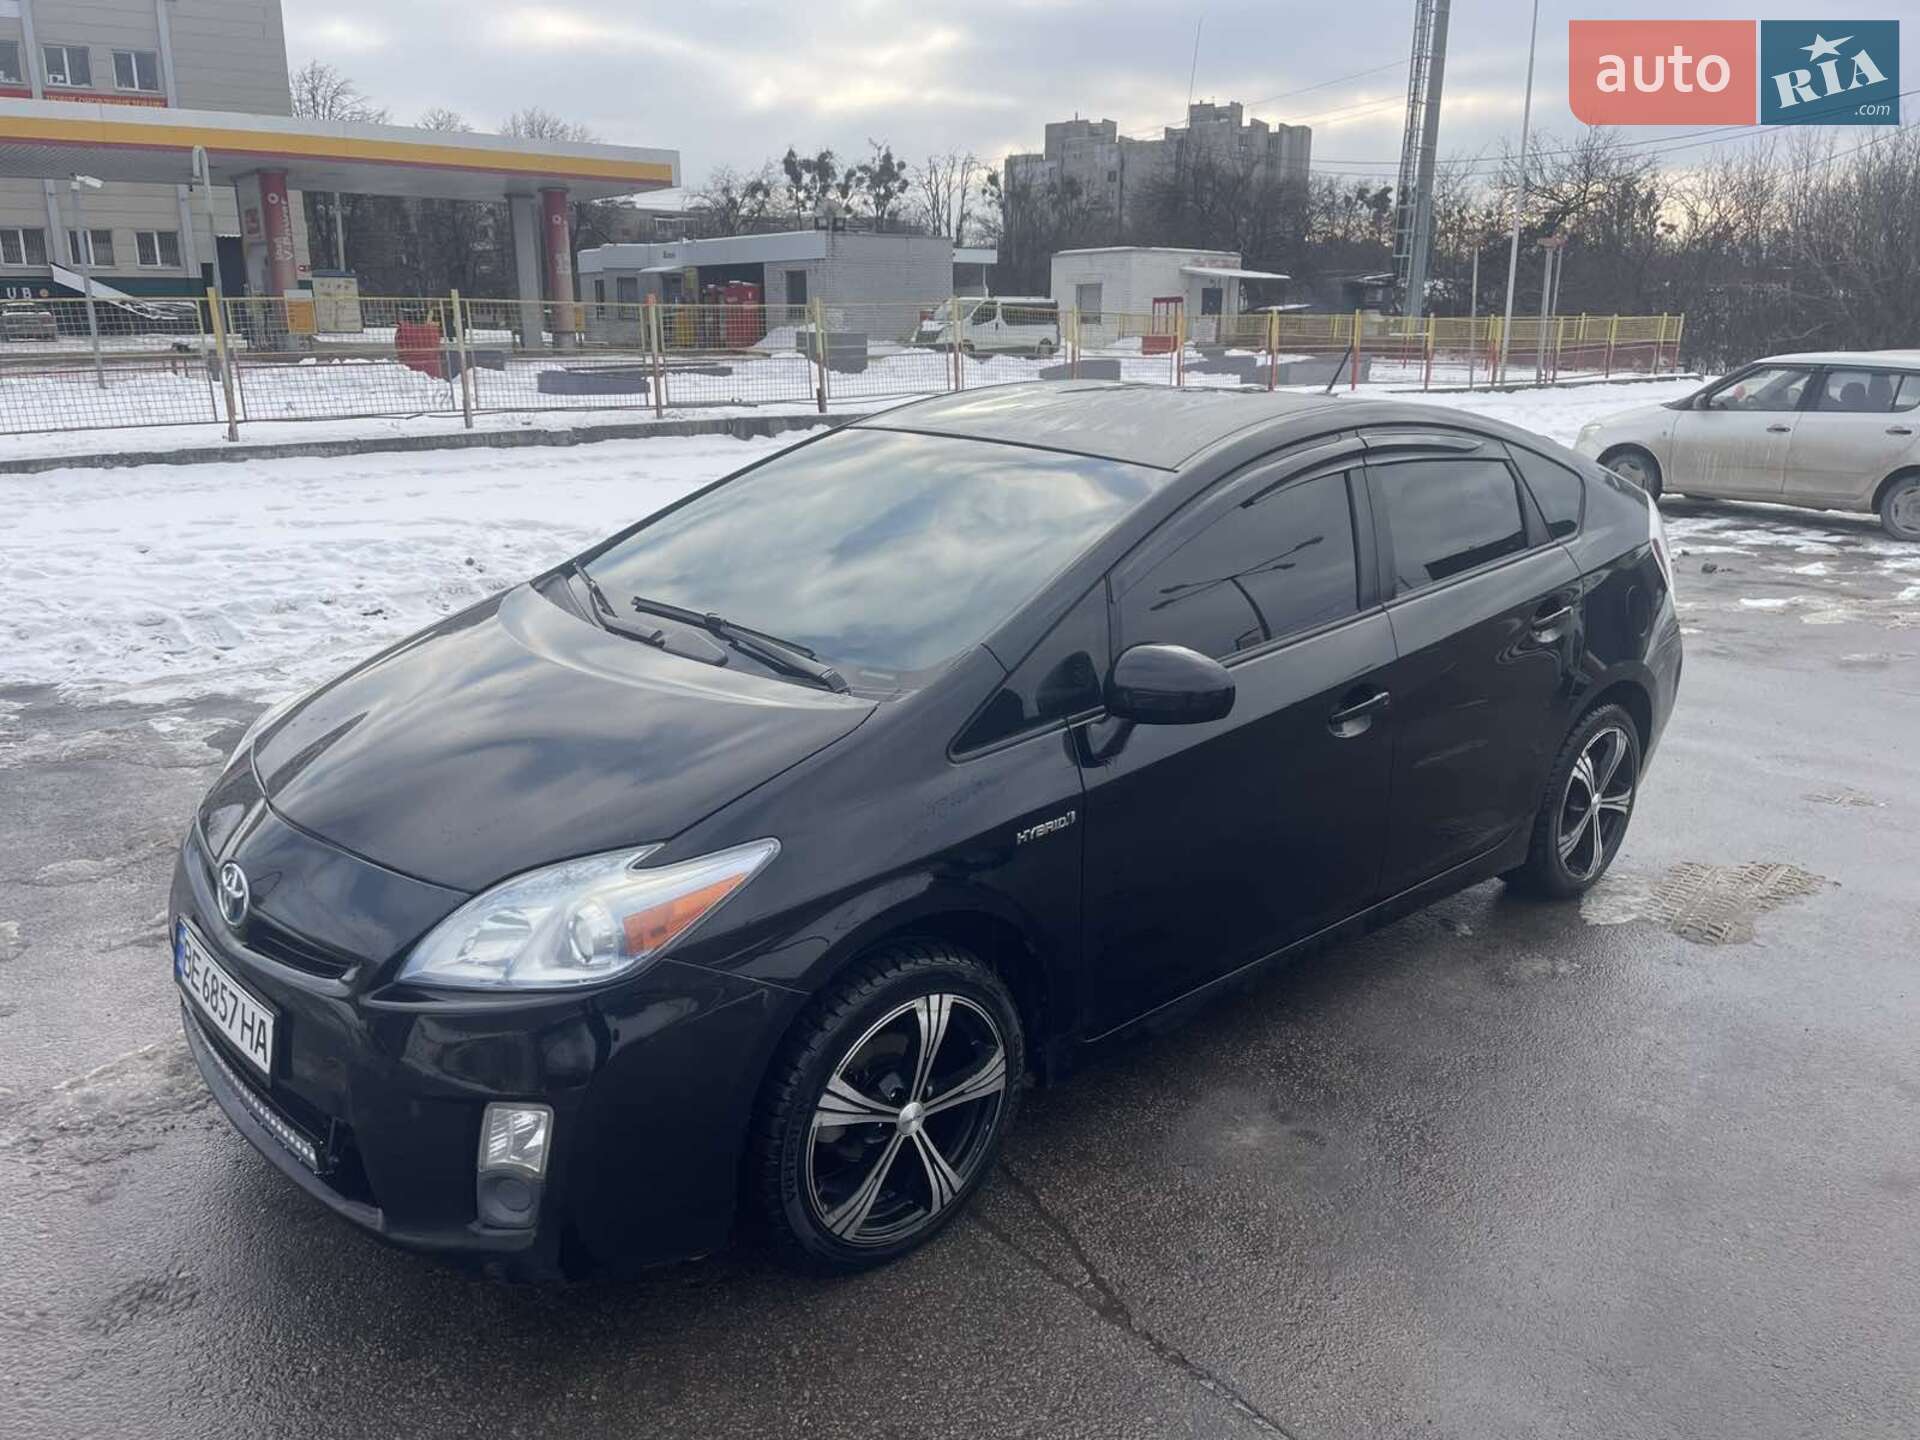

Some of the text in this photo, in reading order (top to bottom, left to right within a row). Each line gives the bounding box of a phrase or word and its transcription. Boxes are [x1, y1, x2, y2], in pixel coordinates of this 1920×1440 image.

[183, 939, 268, 1065] BE 6857 HA
